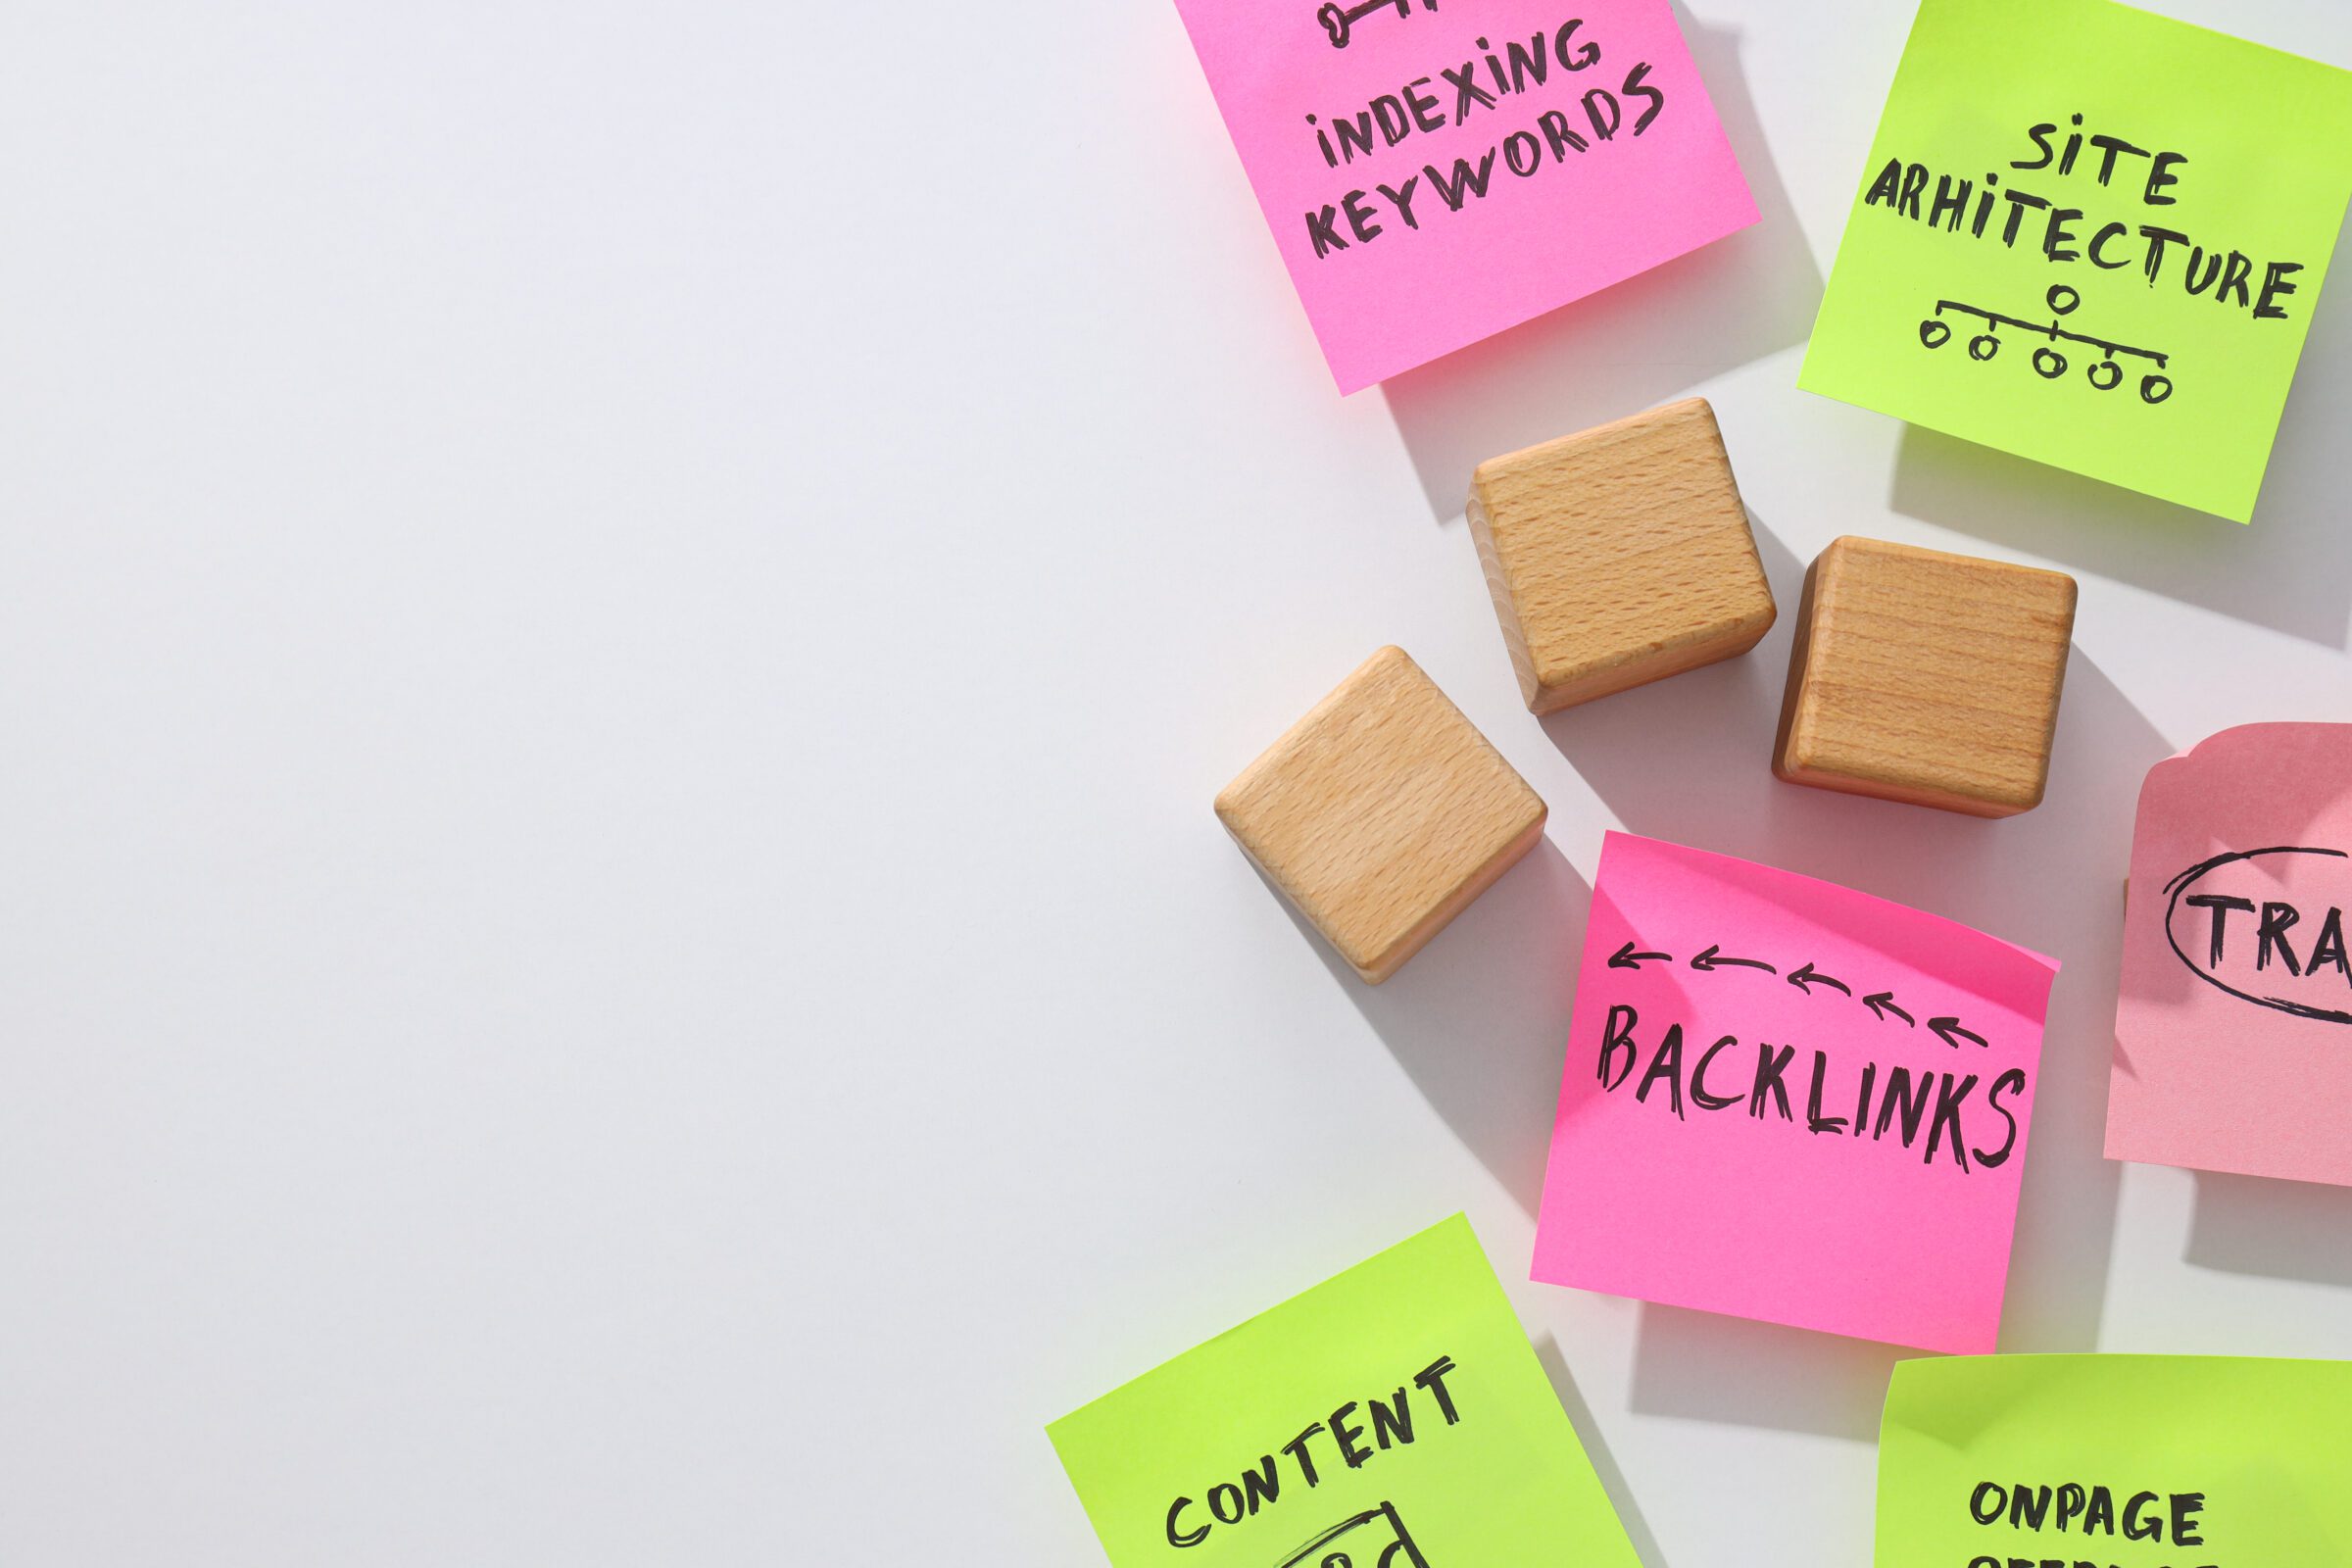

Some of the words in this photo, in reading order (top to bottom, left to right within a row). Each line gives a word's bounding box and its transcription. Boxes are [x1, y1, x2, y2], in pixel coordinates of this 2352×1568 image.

[1304, 62, 1665, 259] KEYWORDS
[1596, 1004, 2026, 1174] BACKLINKS
[1166, 1355, 1460, 1548] CONTENT
[1969, 1482, 2205, 1547] ONPAGE
